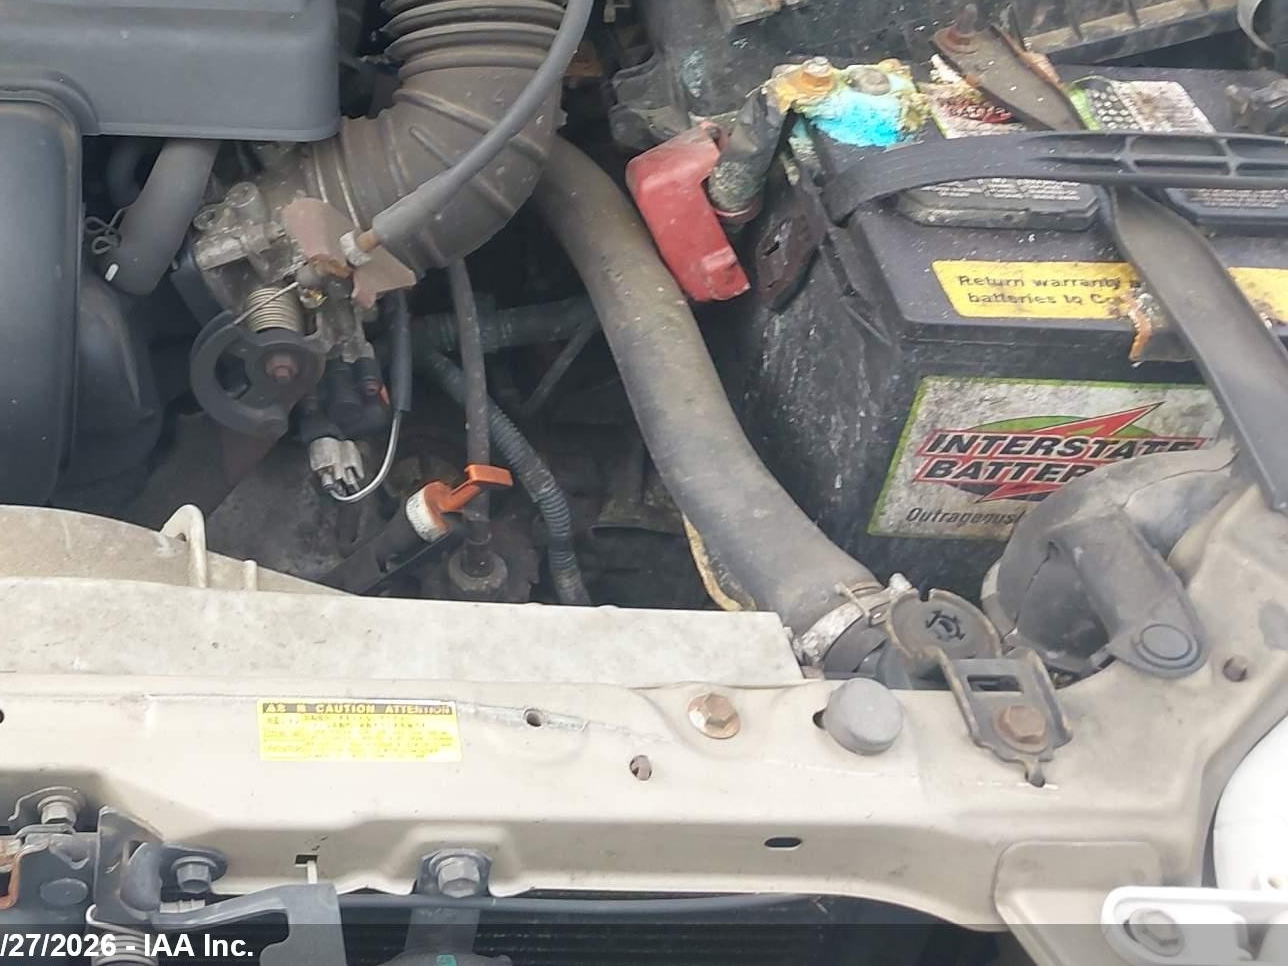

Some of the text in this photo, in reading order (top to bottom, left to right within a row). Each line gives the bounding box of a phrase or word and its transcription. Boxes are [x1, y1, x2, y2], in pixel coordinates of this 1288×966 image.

[958, 274, 1025, 288] Return
[1032, 276, 1122, 291] warranty
[967, 292, 1058, 305] batteries
[1064, 294, 1082, 306] to
[924, 460, 1096, 484] BATTER
[905, 506, 1027, 529] Outrageousl
[315, 704, 376, 714] CAUTION
